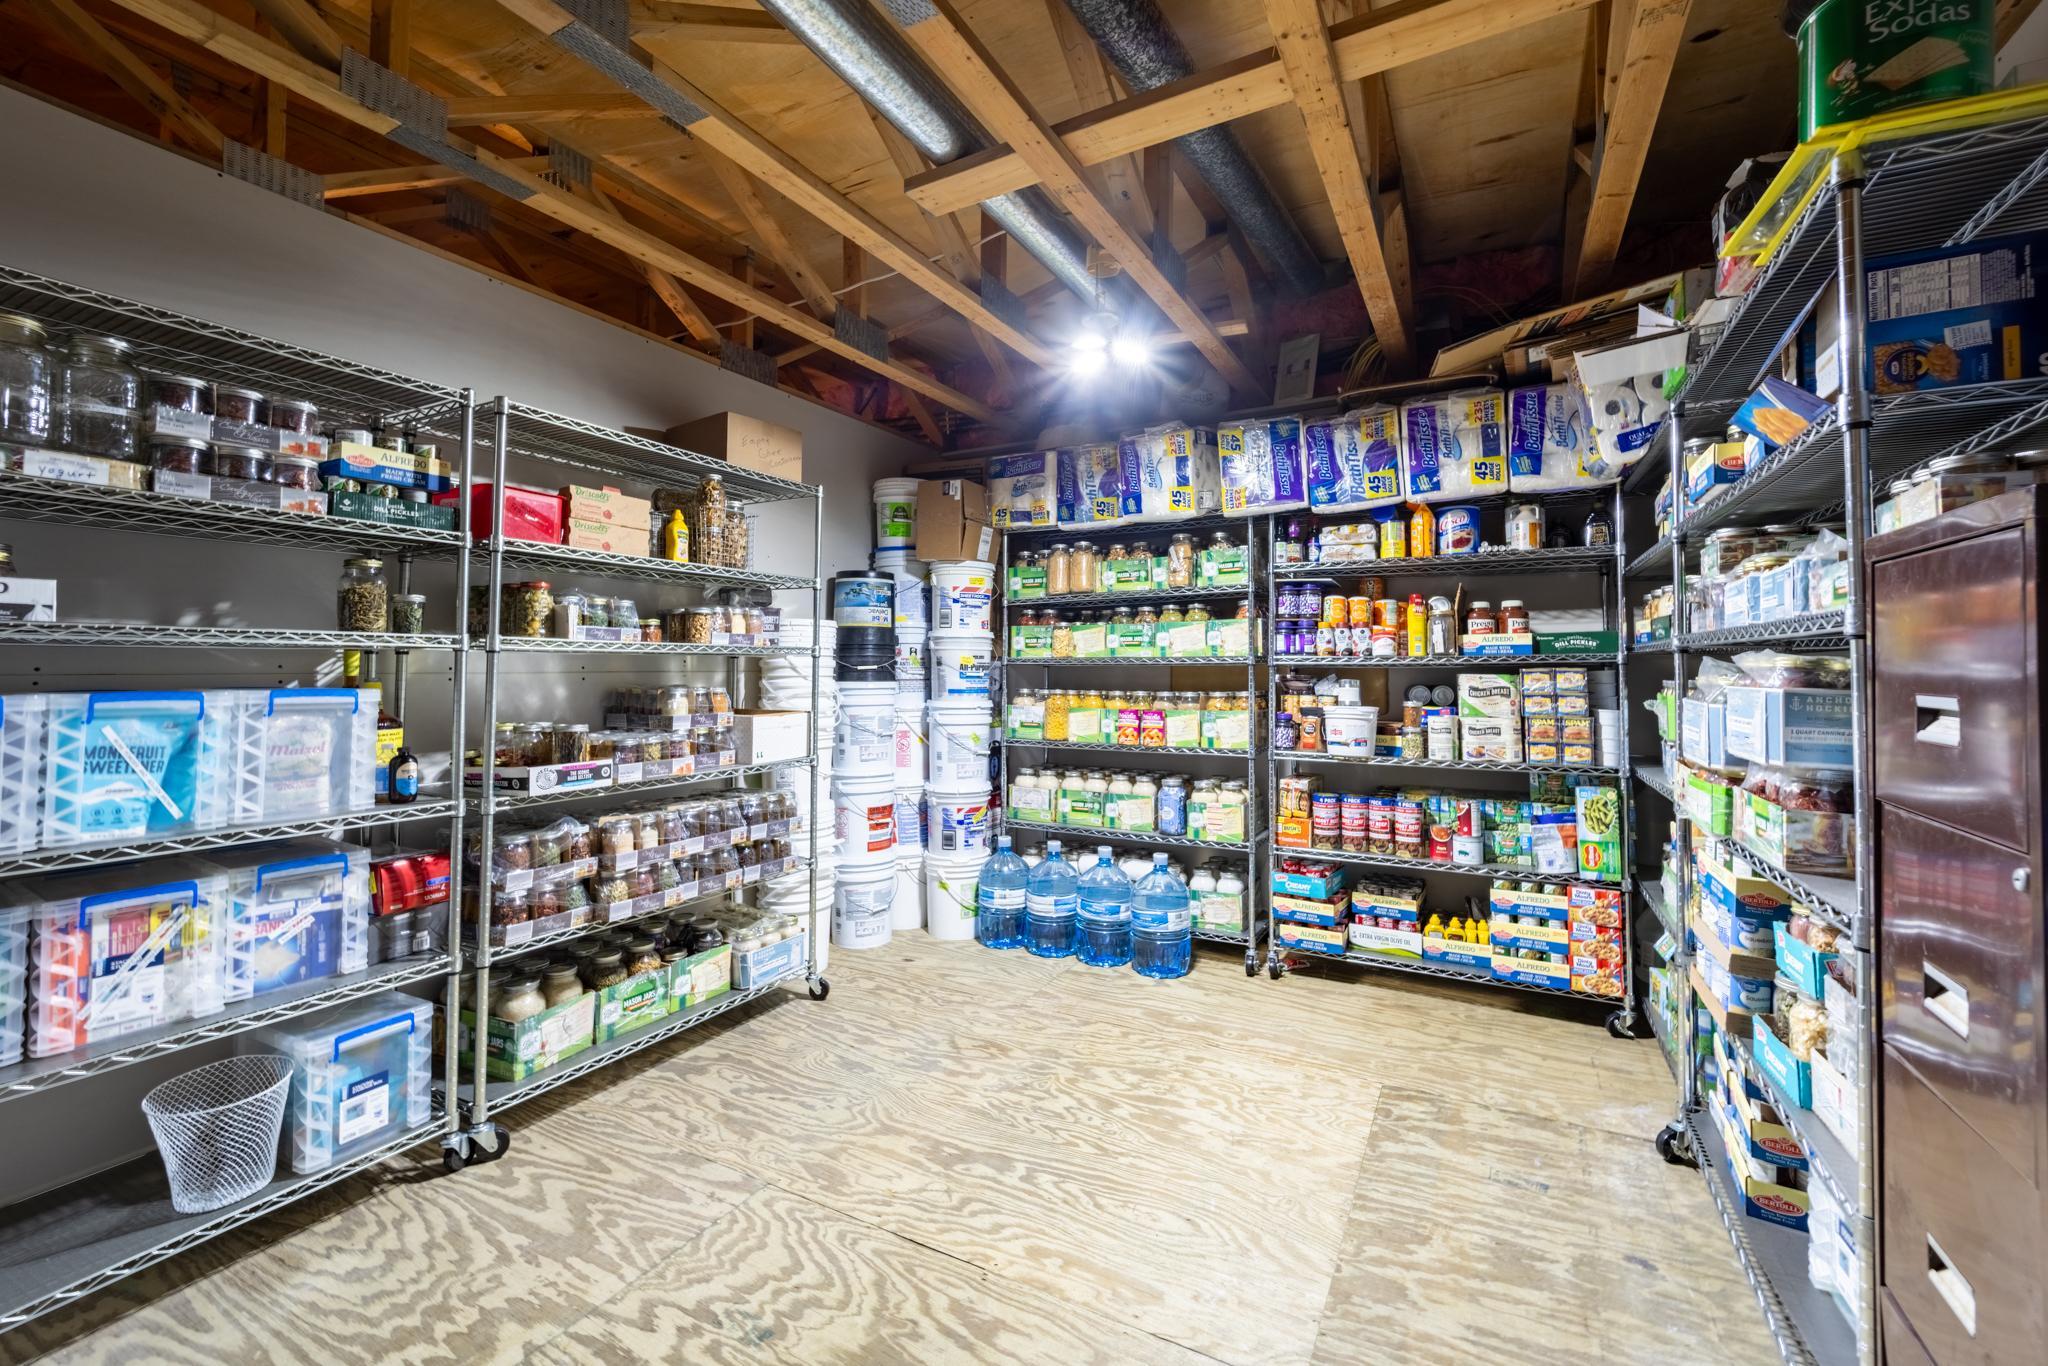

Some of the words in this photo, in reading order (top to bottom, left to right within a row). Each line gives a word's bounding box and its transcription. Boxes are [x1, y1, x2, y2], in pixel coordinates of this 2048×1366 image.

[1868, 4, 1971, 43] Sodas
[1869, 271, 1878, 288] Facts
[1473, 401, 1482, 423] 235
[1366, 417, 1374, 439] 235
[1169, 435, 1177, 454] 235
[1231, 435, 1241, 451] 45
[381, 453, 427, 469] ALFREDO
[39, 465, 96, 480] yogurt
[385, 468, 404, 476] MADE
[406, 471, 422, 479] WITH
[1474, 462, 1488, 480] 45
[403, 477, 426, 485] CREAM
[1368, 475, 1381, 493] 45
[1172, 491, 1181, 507] 45
[390, 507, 419, 517] PICKLES
[995, 508, 1007, 518] 45
[1096, 501, 1105, 516] 45
[1570, 639, 1597, 647] PICKLES
[1806, 696, 1851, 704] ANCHO
[1517, 894, 1549, 904] ALFREDO
[1745, 897, 1777, 906] BERTOLLI
[1293, 902, 1320, 911] ALFREDO
[1300, 931, 1327, 940] ALFREDO
[1516, 928, 1549, 938] ALFREDO
[1445, 943, 1475, 952] ALFREDO
[1517, 962, 1550, 972] ALFREDO
[623, 994, 642, 1008] MASON
[489, 1038, 504, 1048] JARS
[1759, 1197, 1798, 1212] BERTOLLI
